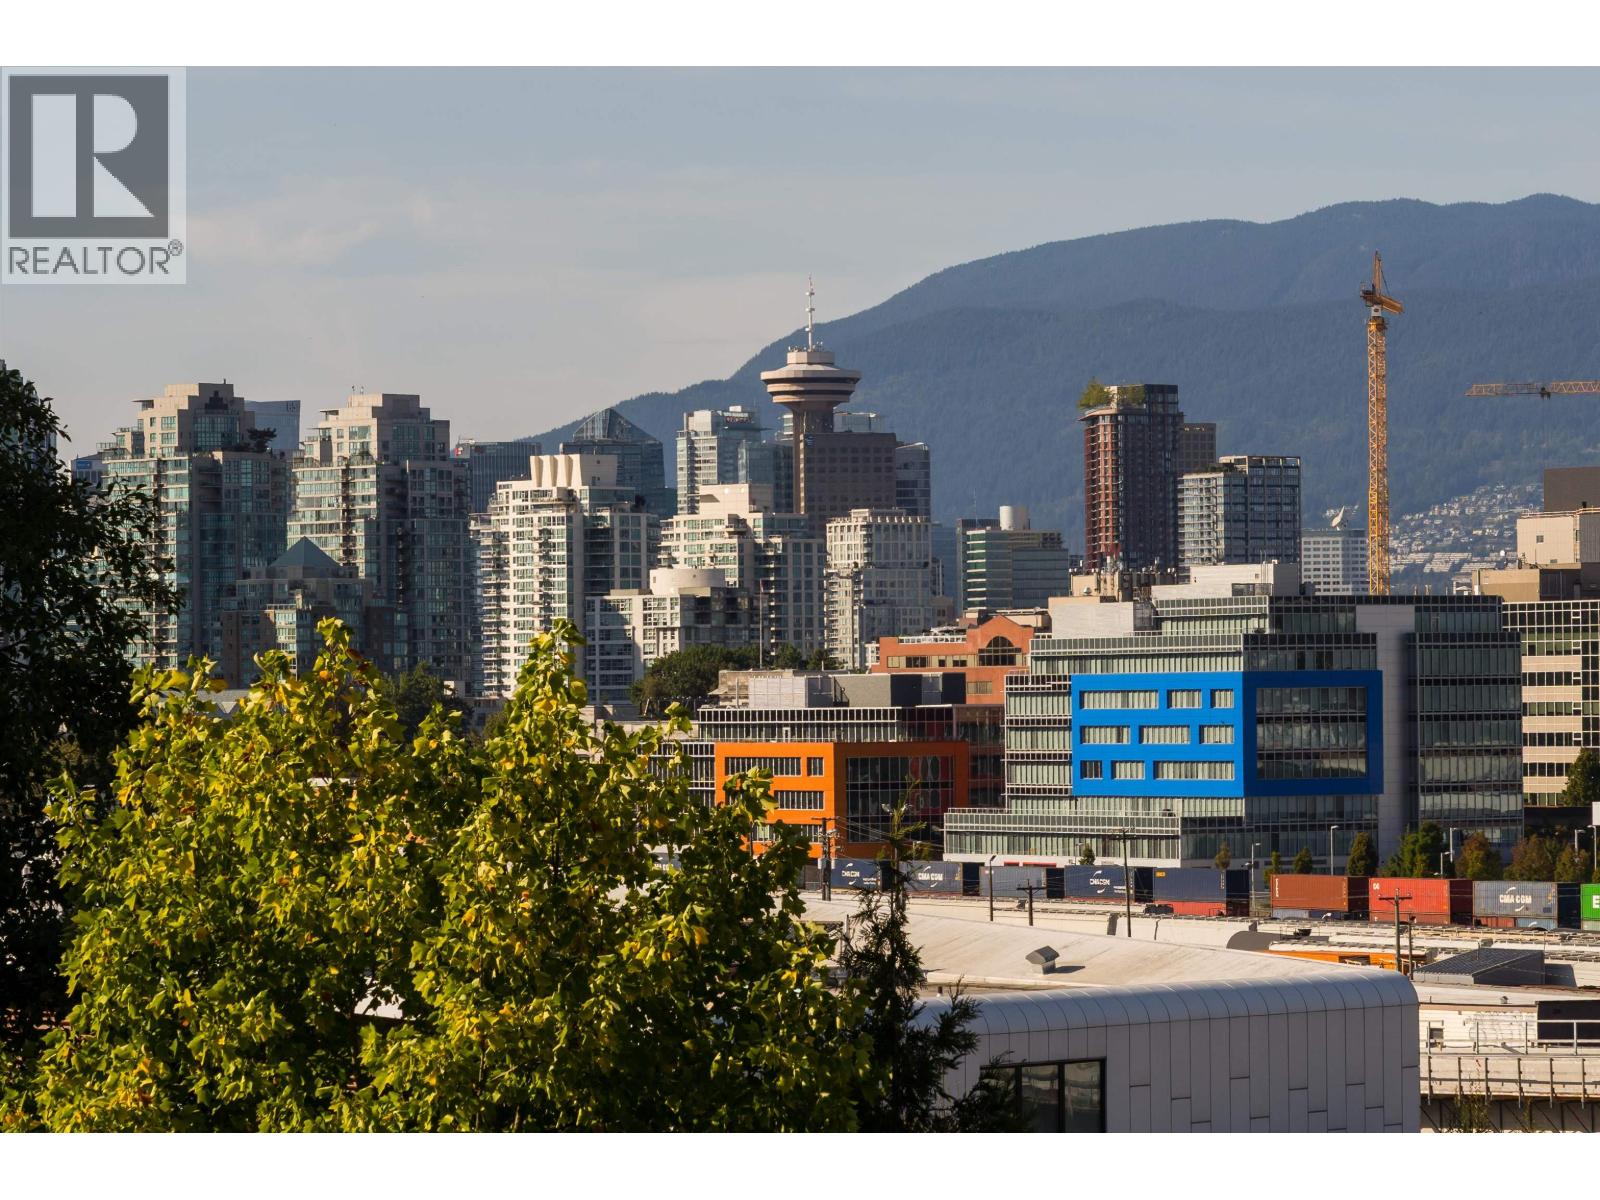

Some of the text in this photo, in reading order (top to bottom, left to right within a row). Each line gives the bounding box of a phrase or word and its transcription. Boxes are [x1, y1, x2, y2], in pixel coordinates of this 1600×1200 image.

[918, 872, 944, 881] CMA CGM
[1499, 894, 1532, 904] CMA CGM
